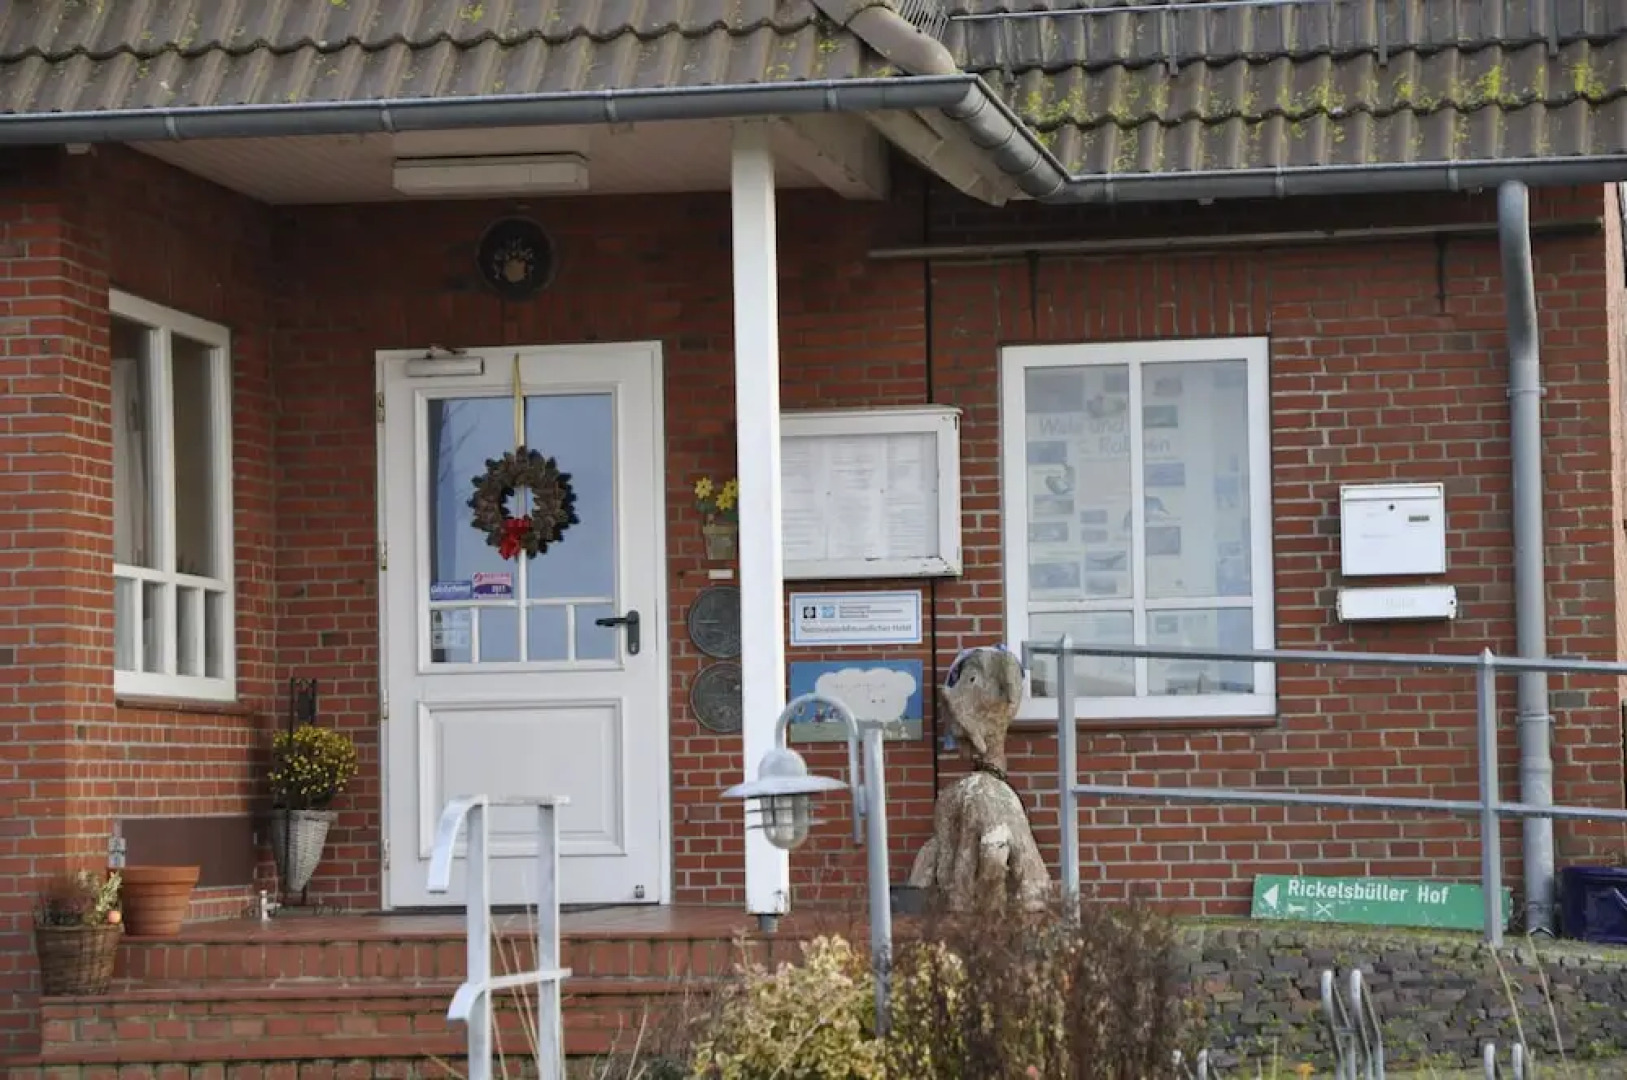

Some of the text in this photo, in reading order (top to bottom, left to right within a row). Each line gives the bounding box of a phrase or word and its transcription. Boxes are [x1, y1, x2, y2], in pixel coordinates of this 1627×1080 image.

[1099, 435, 1171, 454] Roben
[1287, 879, 1450, 905] Rickelsbüller Hof
